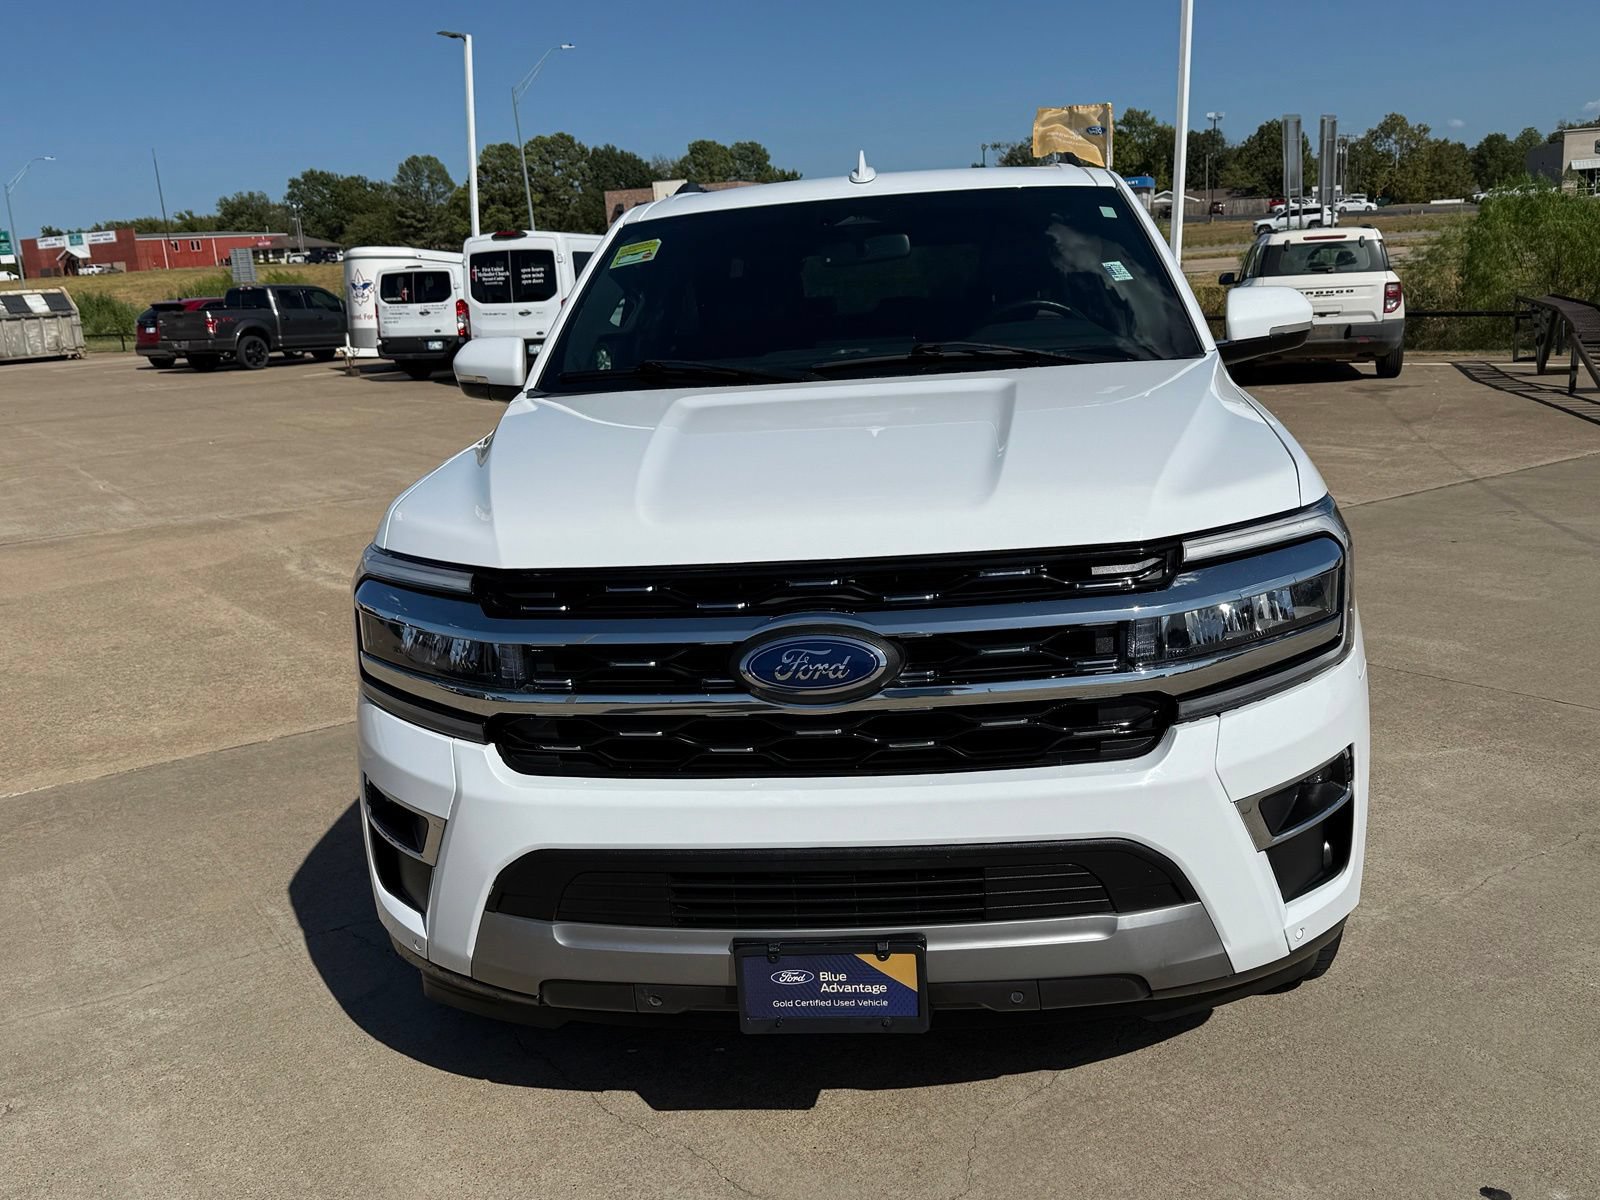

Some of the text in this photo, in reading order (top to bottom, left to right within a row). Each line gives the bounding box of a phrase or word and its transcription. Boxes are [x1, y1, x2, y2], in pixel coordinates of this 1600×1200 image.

[774, 648, 851, 681] Ford
[778, 971, 848, 983] Ford Blue
[820, 983, 888, 995] Advantage
[772, 999, 889, 1008] Gold Certified Used Vehicle
